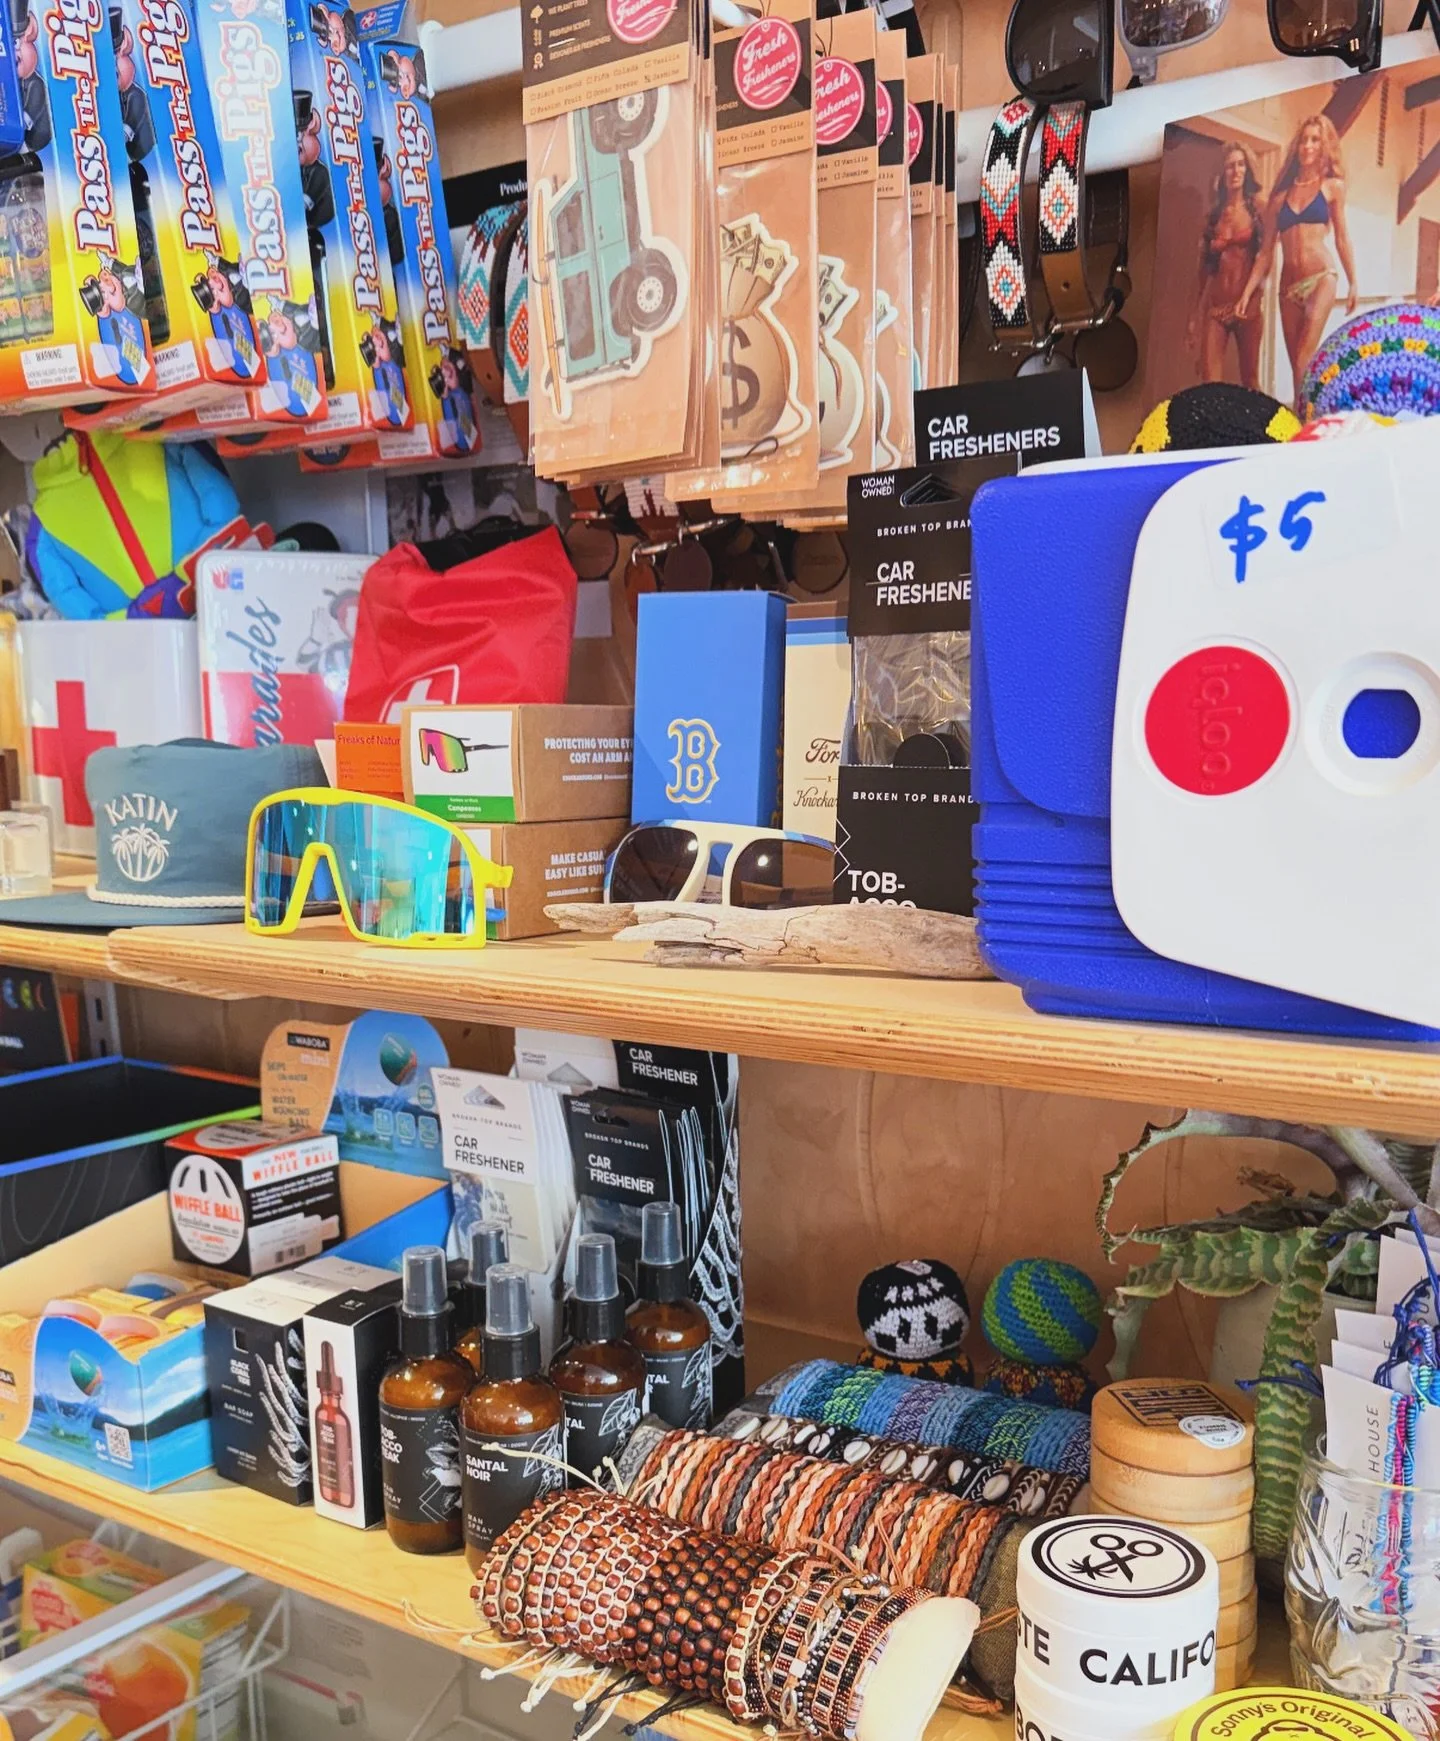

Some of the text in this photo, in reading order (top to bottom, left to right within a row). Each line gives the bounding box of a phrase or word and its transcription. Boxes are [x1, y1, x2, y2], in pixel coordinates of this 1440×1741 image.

[549, 19, 590, 37] PREMIUM SCENTS
[742, 27, 788, 71] Fresh
[652, 54, 680, 66] Vanilla
[652, 69, 680, 81] Jasmine
[742, 52, 796, 93] Fresheners
[76, 77, 98, 130] The
[171, 85, 194, 137] The
[779, 120, 804, 131] Vanilla
[778, 134, 804, 145] Jasmine
[216, 22, 291, 296] Pass The Pigs
[841, 156, 868, 166] Vanilla
[841, 169, 868, 179] Jasmine
[75, 132, 120, 255] Pass
[325, 57, 385, 312] Pass The Pigs
[173, 137, 222, 254] Pass
[397, 103, 449, 345] Pass The Pigs
[928, 415, 969, 438] CAR
[929, 427, 1061, 461] FRESHENERS
[861, 475, 895, 487] WOMAN
[861, 486, 892, 498] OWNED
[877, 525, 917, 537] BROKEN
[922, 521, 941, 532] TOP
[877, 560, 915, 583] CAR
[338, 735, 365, 745] Freaks
[366, 735, 375, 745] of
[544, 738, 597, 750] PROTECTING
[597, 738, 620, 749] YOUR
[570, 752, 591, 764] COST
[592, 752, 604, 763] AN
[605, 752, 623, 762] ARM
[665, 718, 722, 804] B
[853, 791, 898, 801] BROKEN
[904, 793, 927, 802] TOP
[104, 793, 178, 832] KATIN
[551, 853, 577, 865] MAKE
[545, 868, 568, 880] EASY
[568, 866, 587, 878] LIKE
[848, 870, 905, 894] TOB-
[521, 1052, 546, 1060] WOMAN
[629, 1048, 653, 1063] CAR
[632, 1062, 698, 1086] FRESHENER
[454, 1135, 478, 1150] CAR
[274, 1150, 297, 1161] NEW
[455, 1150, 525, 1174] FRESHENER
[588, 1153, 611, 1170] CAR
[252, 1151, 334, 1181] WIFFLE BALL
[590, 1169, 654, 1195] FRESHENER
[173, 1194, 210, 1216] WIFFLE
[214, 1200, 241, 1223] BALL
[230, 1359, 249, 1371] BLACK
[1366, 1405, 1381, 1474] HOUSE
[465, 1454, 509, 1472] SANTAL
[466, 1466, 491, 1482] NOIR
[467, 1514, 483, 1525] MAN
[467, 1521, 493, 1535] SPRAY
[1079, 1629, 1215, 1686] CALIFO
[1211, 1701, 1375, 1739] Sonny's Original
